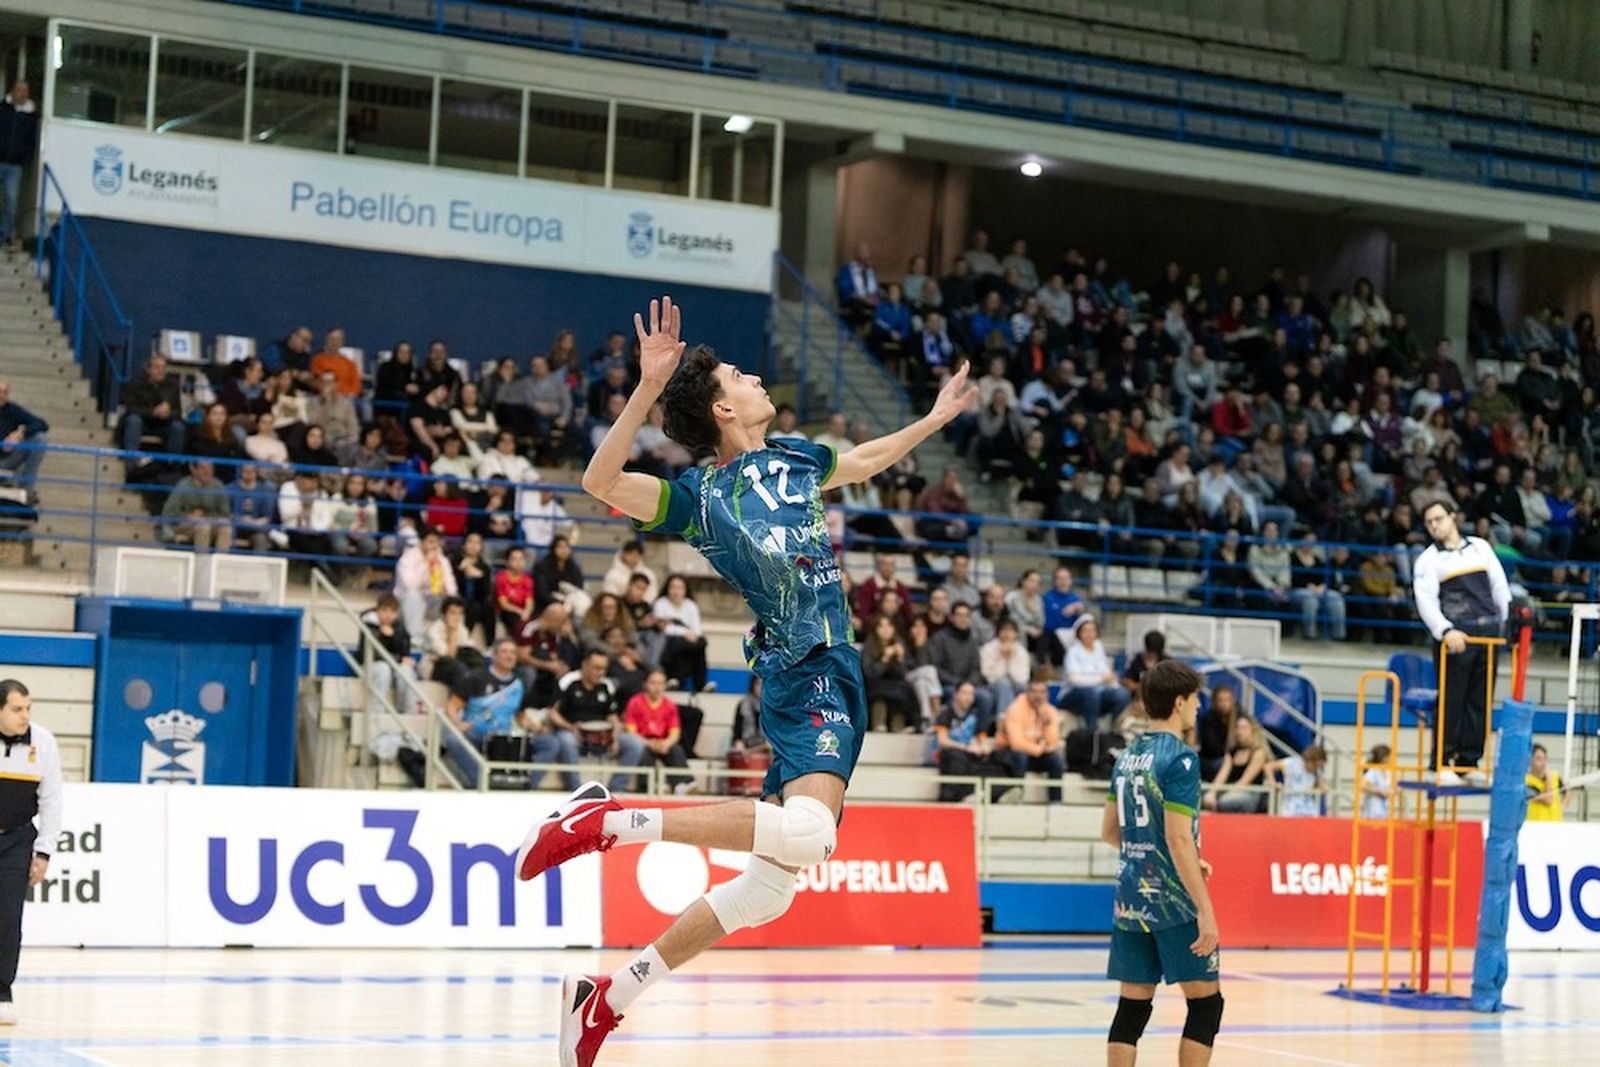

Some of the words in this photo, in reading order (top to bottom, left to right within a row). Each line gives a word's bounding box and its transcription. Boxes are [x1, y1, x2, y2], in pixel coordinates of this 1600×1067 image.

[128, 162, 218, 191] Leganés
[291, 181, 436, 228] Pabellón
[448, 200, 564, 246] Europa
[658, 227, 735, 253] Leganés
[742, 460, 806, 512] 12
[1115, 776, 1150, 827] 15
[56, 823, 102, 853] ad
[207, 808, 563, 926] uc3m
[795, 859, 949, 893] SUPERLIGA
[1270, 855, 1389, 896] LEGANÉS
[26, 869, 101, 903] rid
